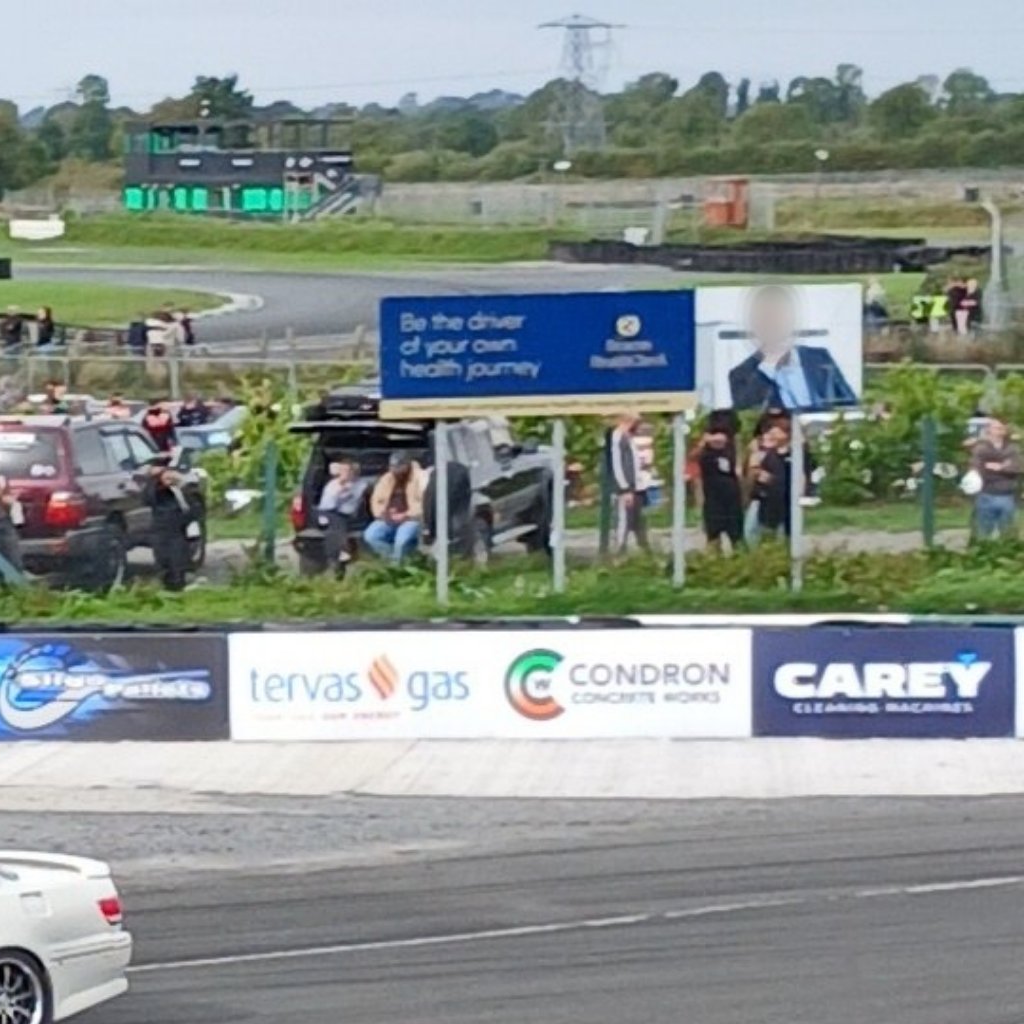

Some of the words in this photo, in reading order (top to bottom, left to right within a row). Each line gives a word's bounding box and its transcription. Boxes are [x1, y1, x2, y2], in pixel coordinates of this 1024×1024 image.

[399, 313, 426, 332] Be
[431, 313, 463, 331] the
[467, 311, 525, 330] driver
[425, 339, 468, 358] your
[472, 339, 518, 354] own
[399, 359, 462, 378] health
[466, 359, 542, 382] journey
[569, 663, 730, 687] CONDRON
[774, 660, 992, 698] CAREY
[250, 668, 362, 703] tervas
[407, 670, 470, 711] gas
